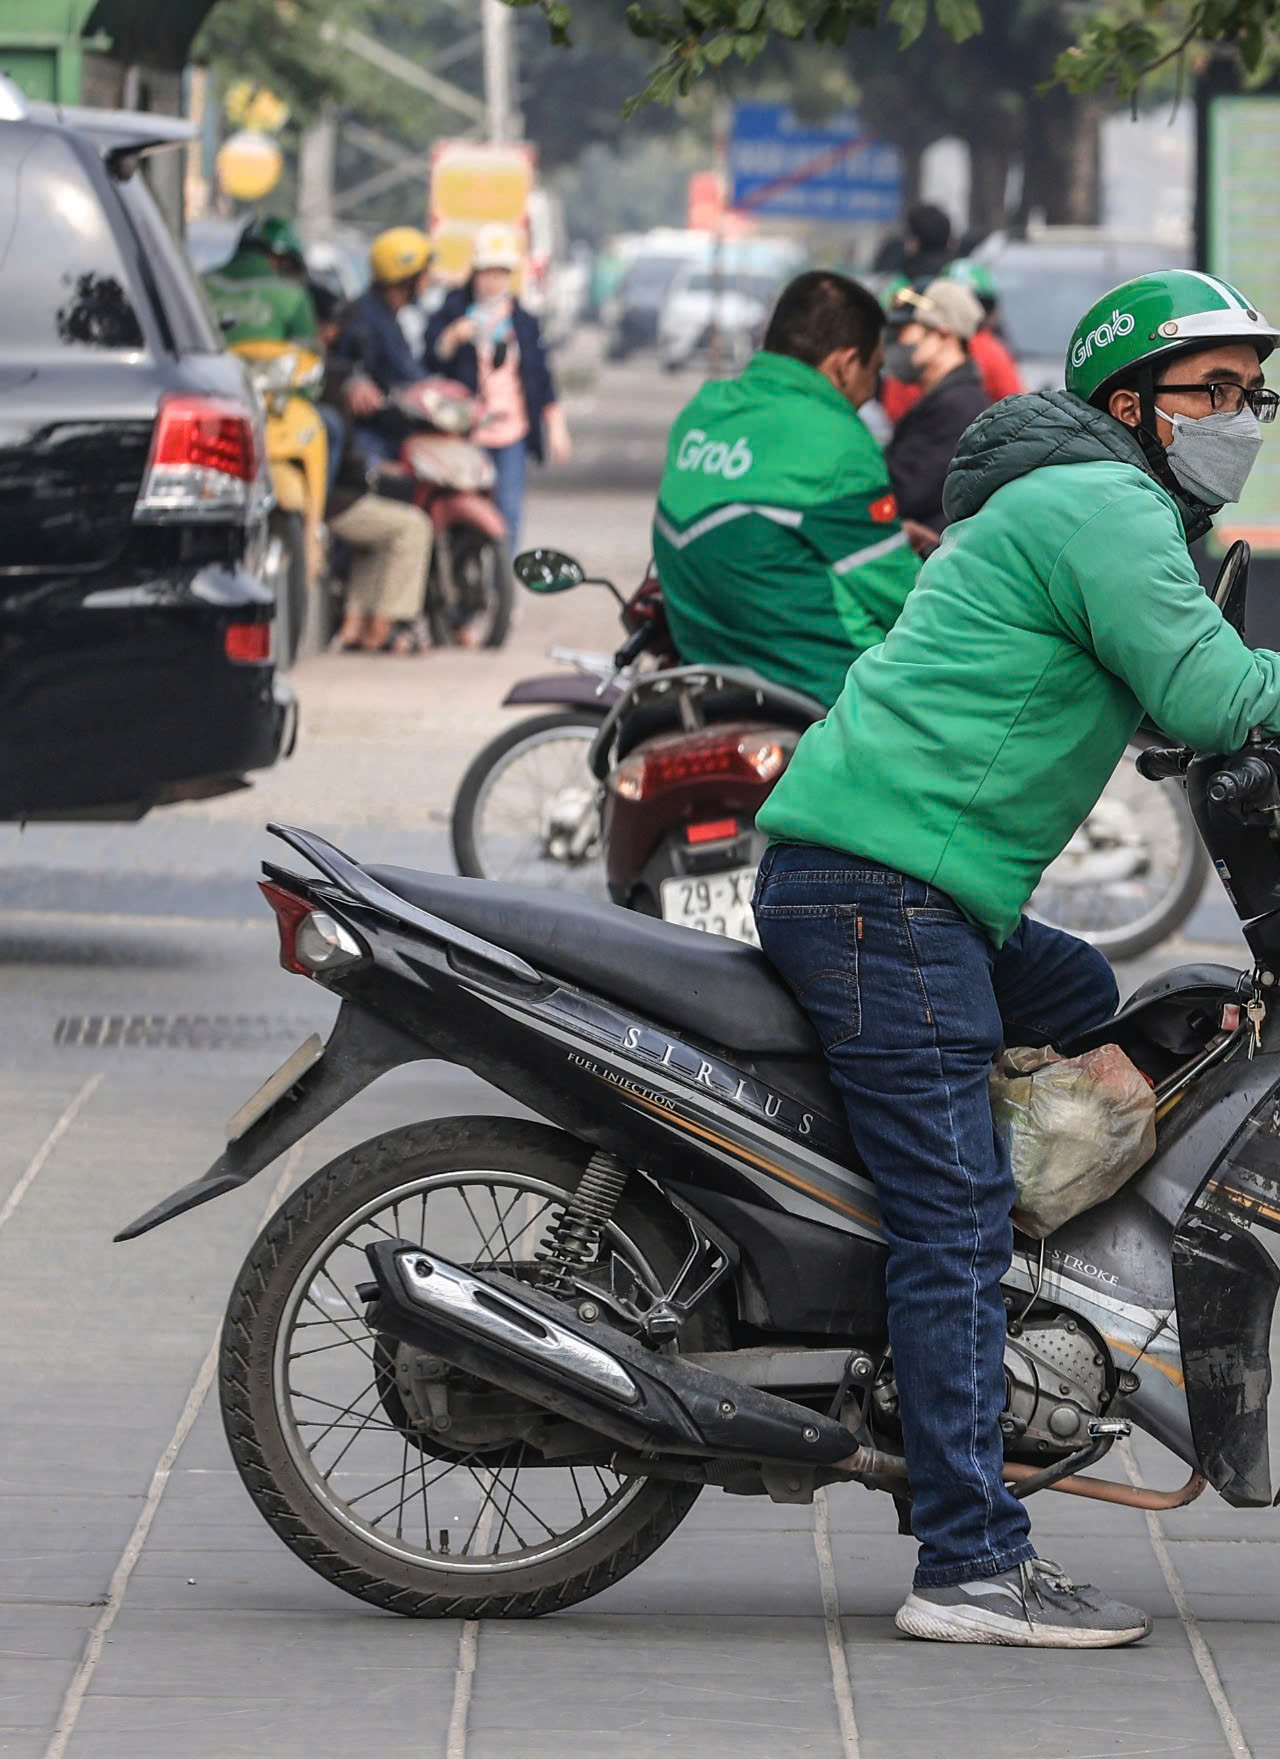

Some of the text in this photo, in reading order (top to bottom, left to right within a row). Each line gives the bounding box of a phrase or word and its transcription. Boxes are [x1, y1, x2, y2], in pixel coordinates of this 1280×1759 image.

[1071, 309, 1135, 368] Grab
[676, 428, 753, 480] Grab
[567, 1052, 677, 1110] FUEL INJECTION
[622, 1024, 814, 1135] SIRIUS
